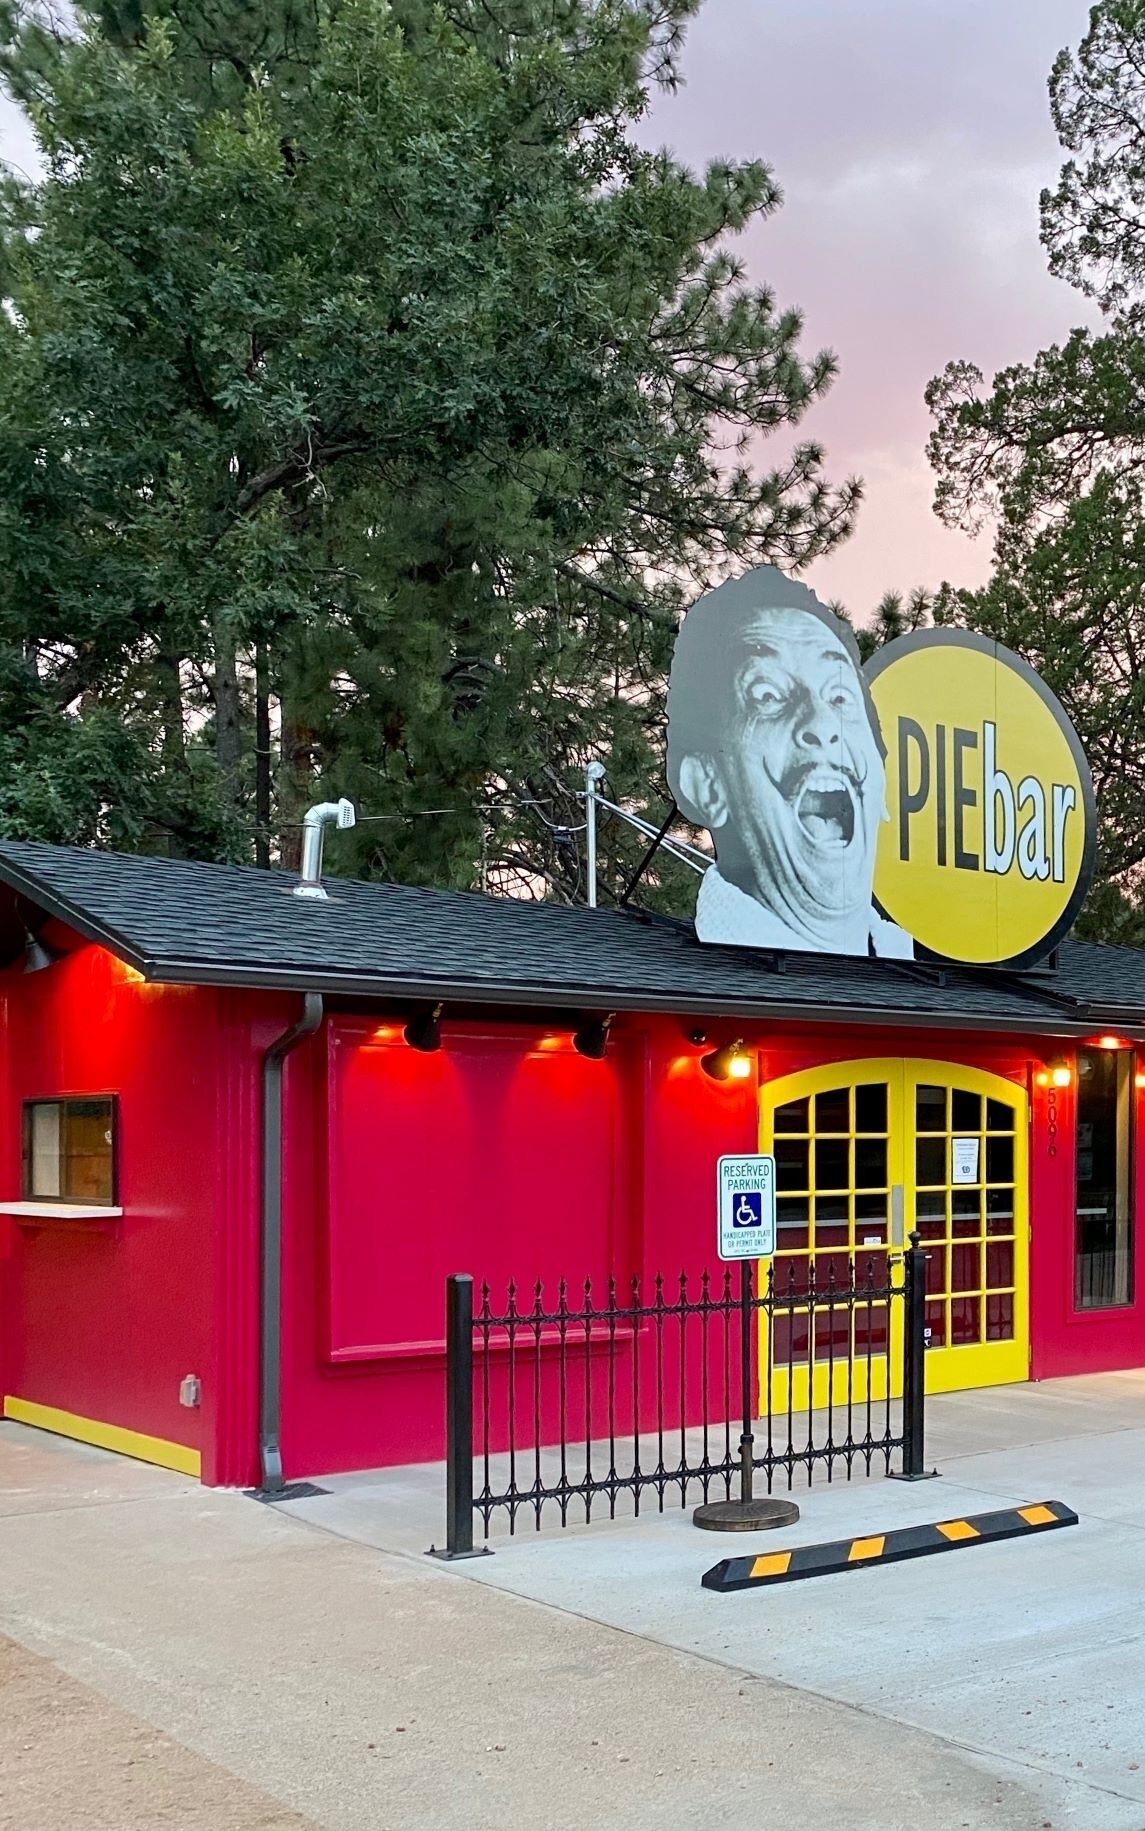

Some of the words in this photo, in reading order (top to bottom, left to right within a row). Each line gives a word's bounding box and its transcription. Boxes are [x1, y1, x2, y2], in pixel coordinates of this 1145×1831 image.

[897, 715, 1076, 884] PIEbar
[723, 1164, 770, 1177] RESERVED
[727, 1178, 766, 1190] PARKING
[723, 1230, 756, 1239] HANDICAPPED
[757, 1229, 771, 1237] PLATE
[728, 1240, 735, 1248] OR
[736, 1239, 753, 1247] PERMIT
[754, 1238, 767, 1246] ONLY
